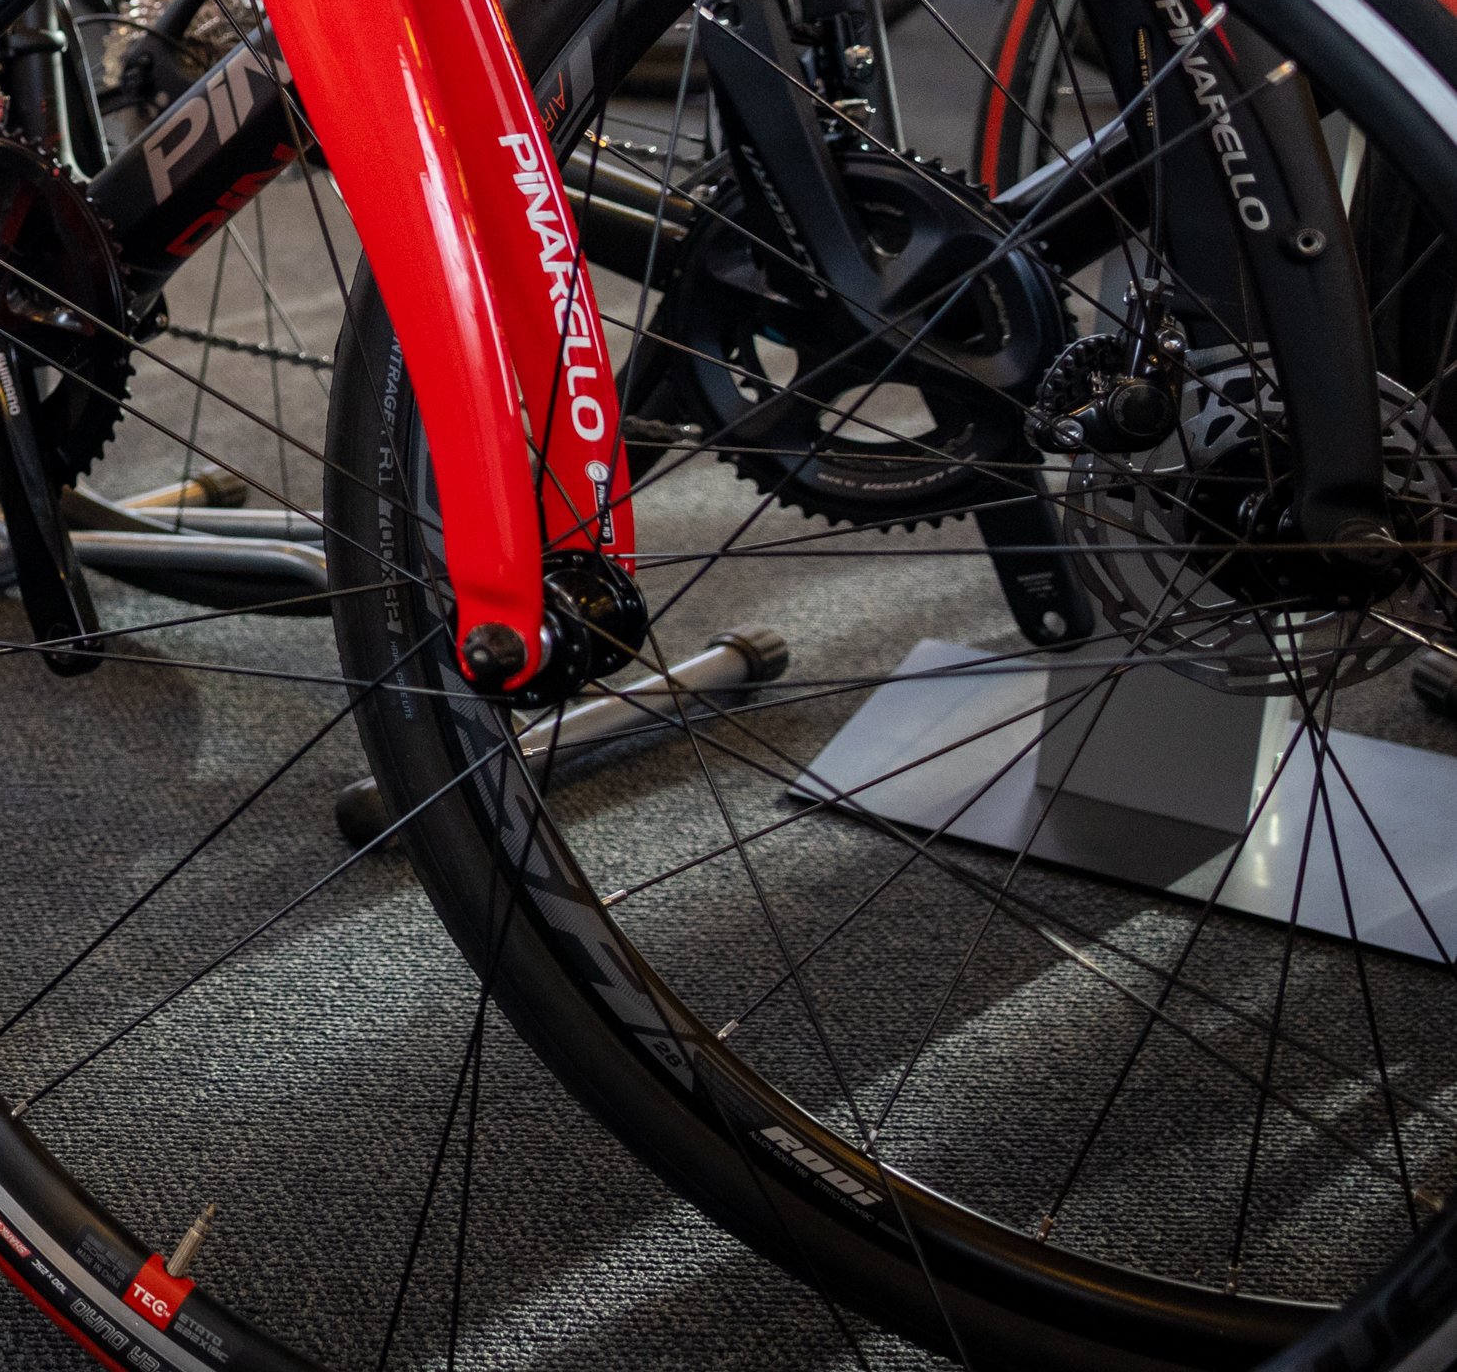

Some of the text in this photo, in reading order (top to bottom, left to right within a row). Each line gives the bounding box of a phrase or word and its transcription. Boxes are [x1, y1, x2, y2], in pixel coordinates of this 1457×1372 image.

[498, 133, 606, 442] PINARELLO
[1, 1226, 30, 1255] SHARK
[69, 1297, 129, 1350] DURO
